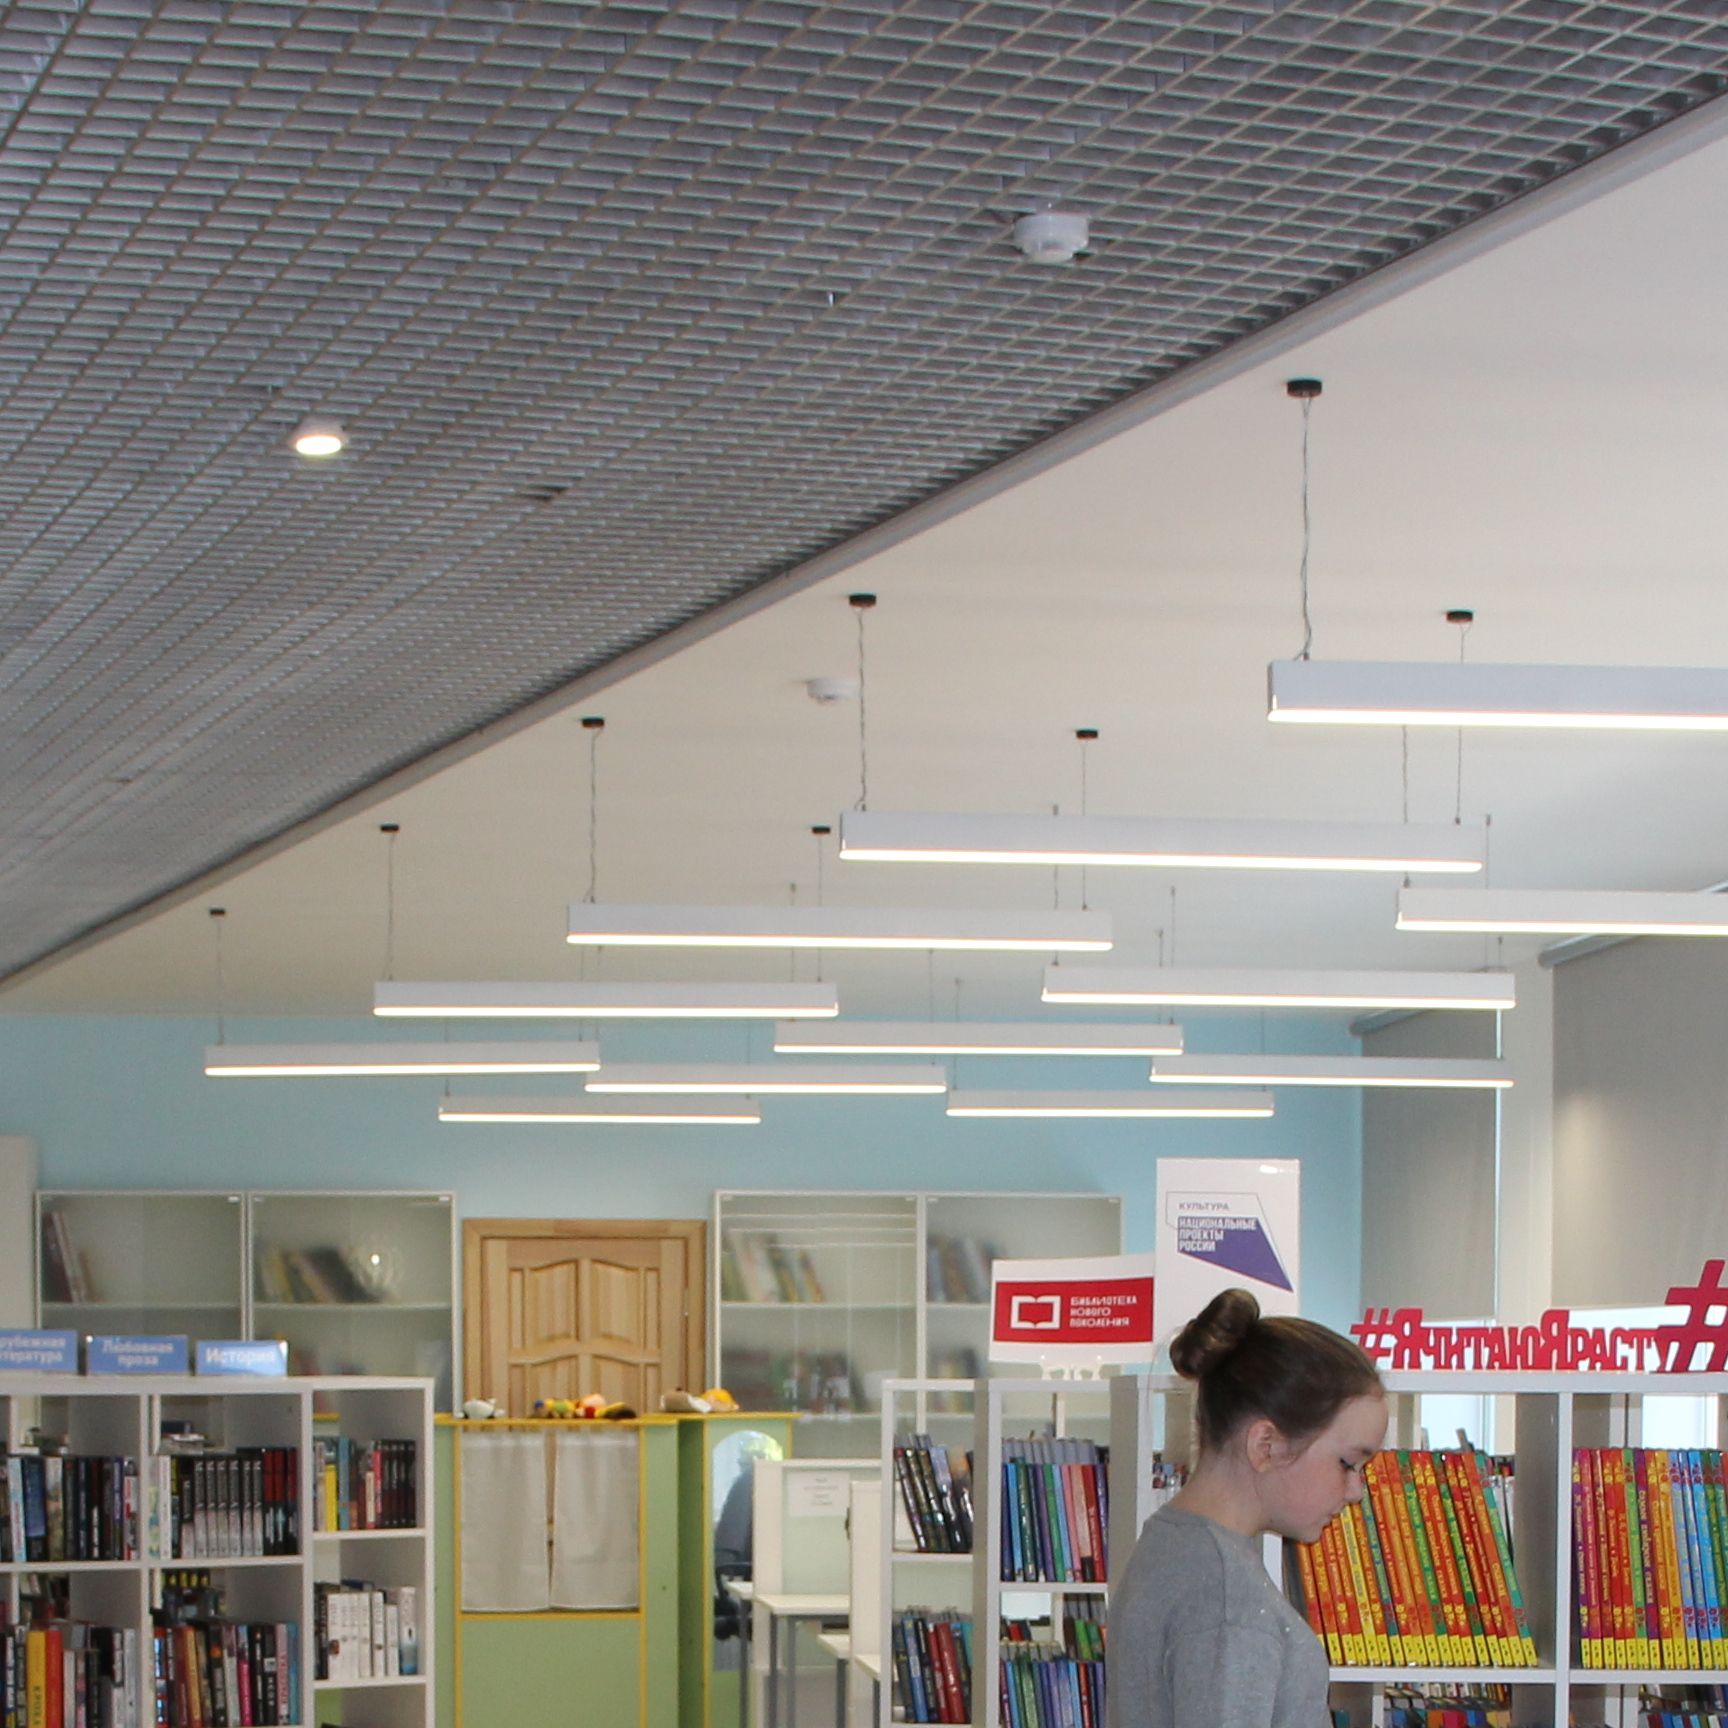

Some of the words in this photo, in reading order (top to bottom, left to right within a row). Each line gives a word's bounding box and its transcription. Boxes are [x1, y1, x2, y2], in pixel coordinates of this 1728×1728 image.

[1178, 1202, 1230, 1212] КУЛЬТУРА
[1178, 1218, 1257, 1231] НАЦИОНАЛЬНЫЕ
[1178, 1229, 1224, 1241] ПРОЕКТЫ
[1178, 1240, 1216, 1252] РОССИИ
[1069, 1295, 1138, 1307] БИБЛИОТЕКА
[1069, 1307, 1112, 1317] НОВОГО
[1069, 1317, 1130, 1328] ПОКОЛЕНИЯ
[102, 1338, 174, 1354] Любовная
[118, 1354, 159, 1367] проза
[205, 1348, 275, 1363] История
